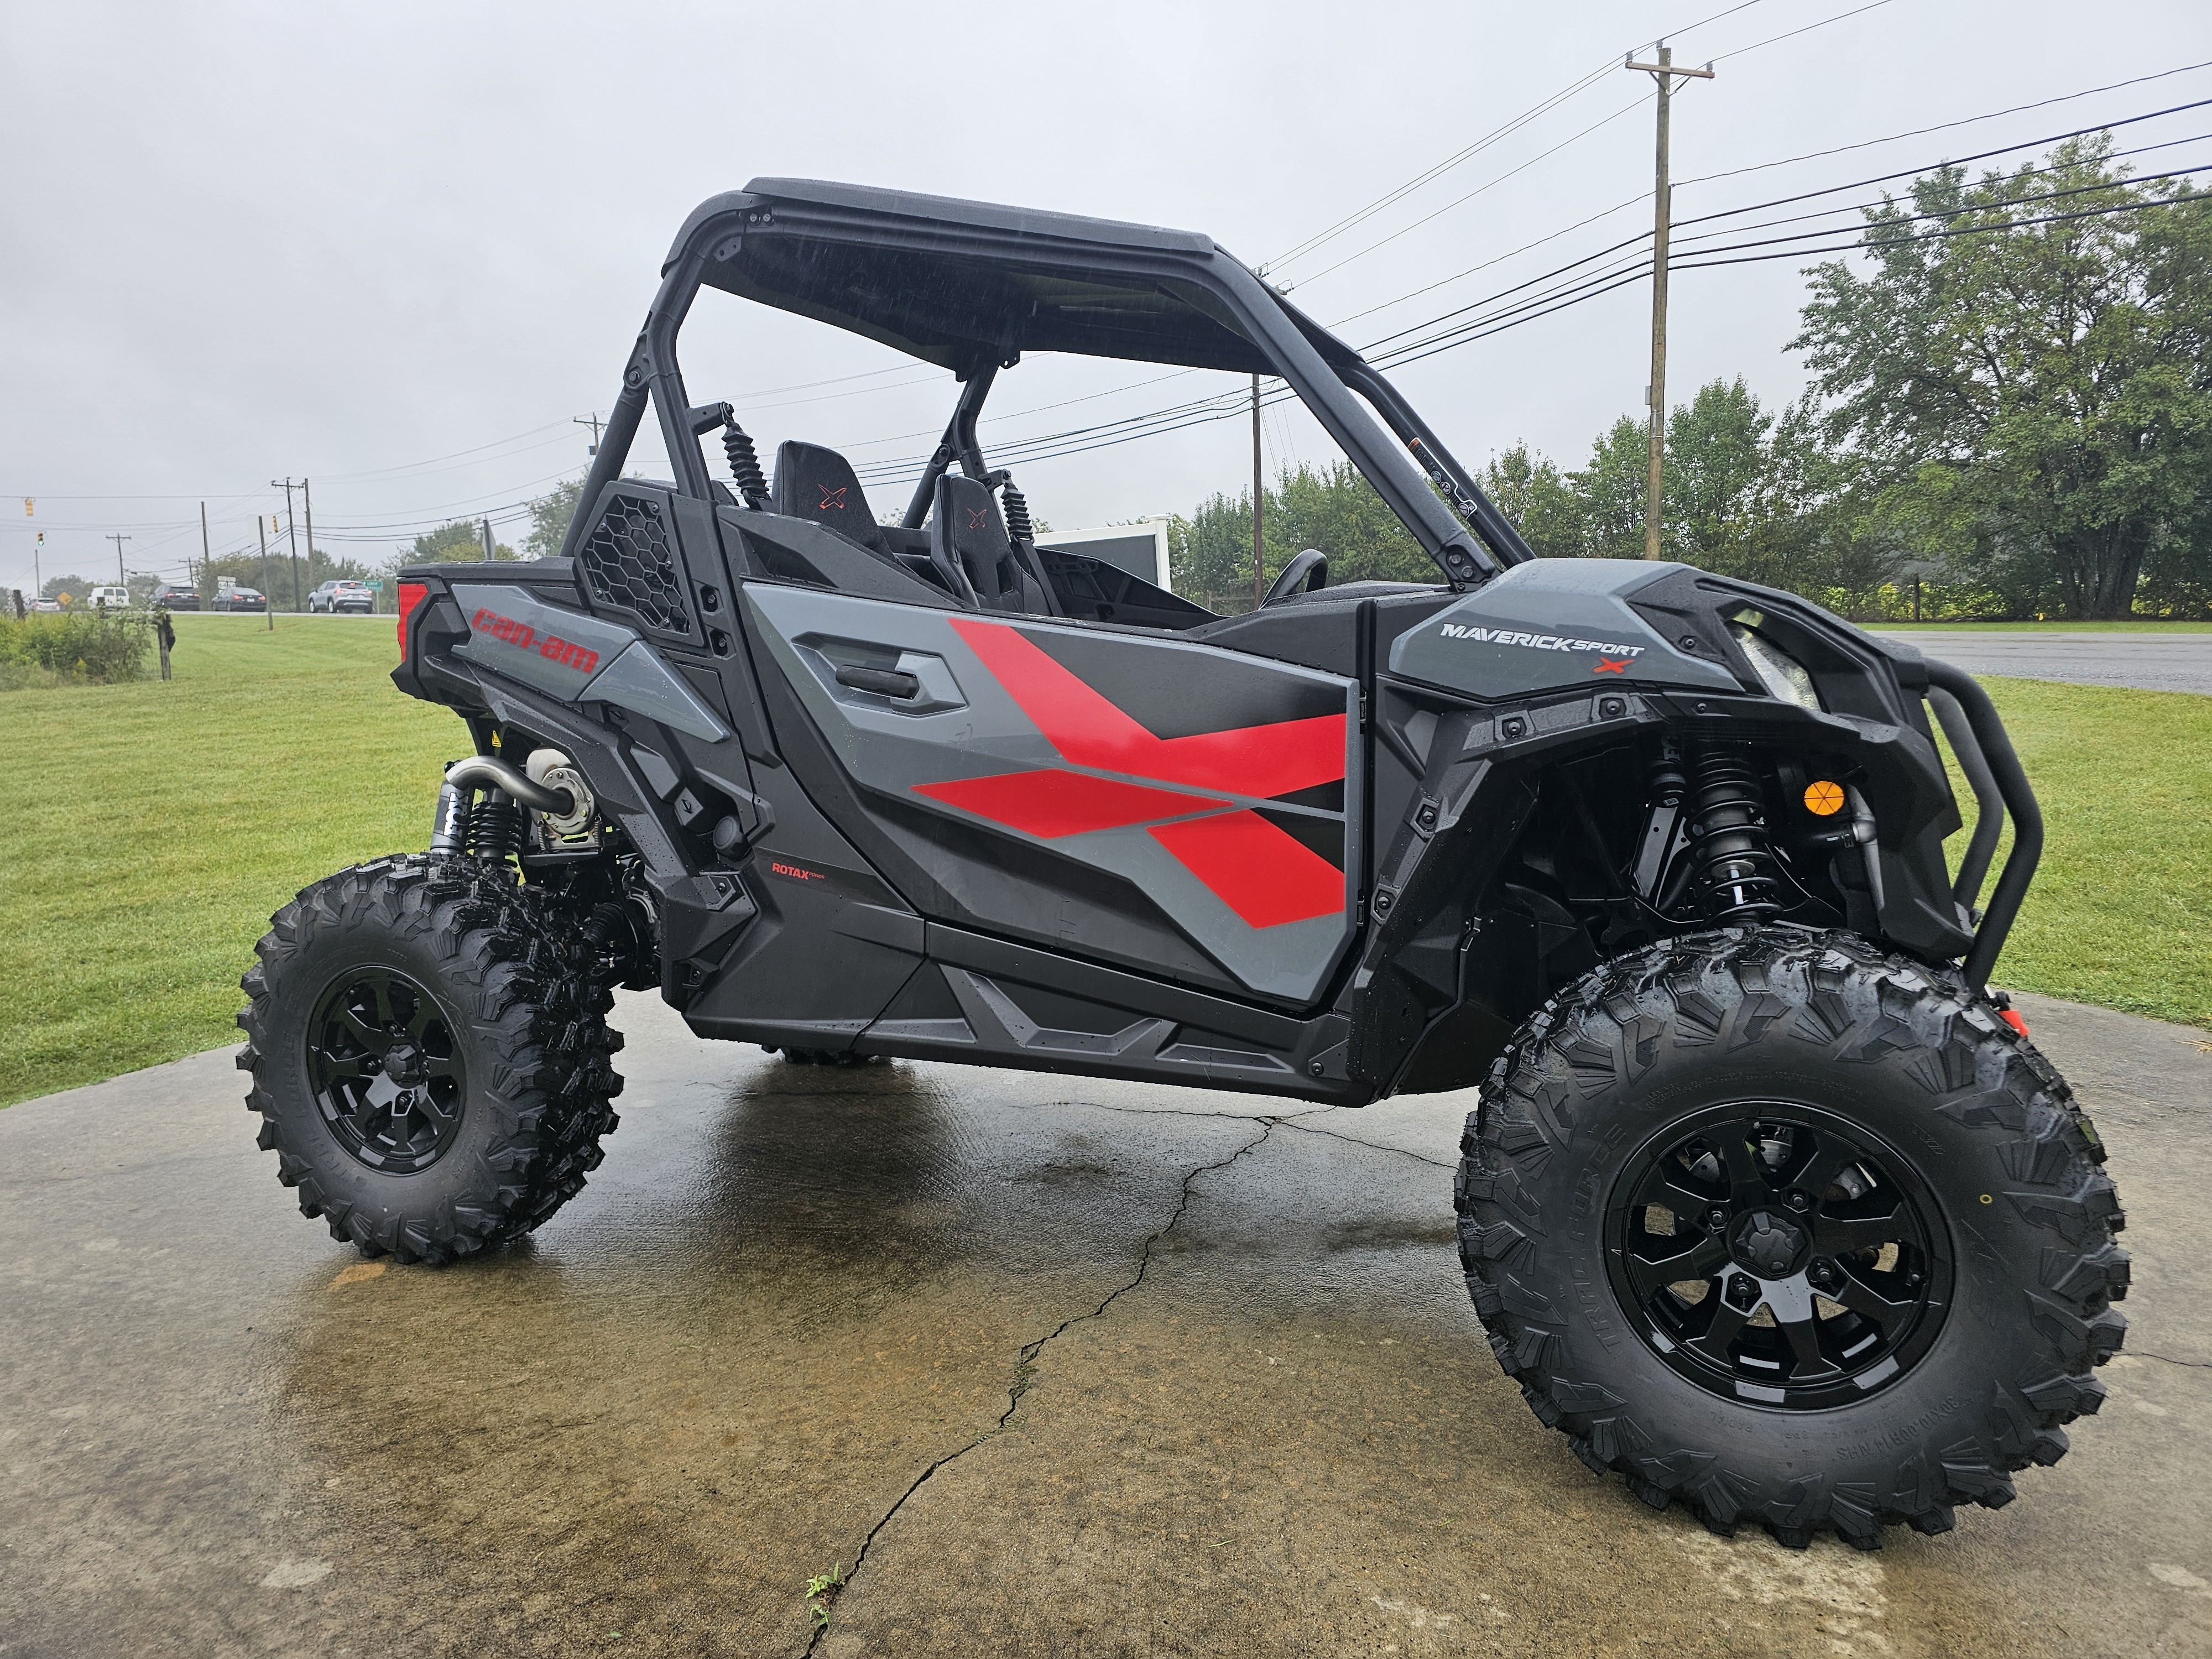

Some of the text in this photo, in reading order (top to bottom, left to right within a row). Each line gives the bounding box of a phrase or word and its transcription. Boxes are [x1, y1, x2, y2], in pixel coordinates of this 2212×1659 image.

[471, 607, 599, 674] can-am
[1440, 623, 1645, 656] MAVERICK SPORT
[444, 792, 469, 838] FOX
[772, 863, 809, 880] ROTAX
[1567, 1123, 1627, 1354] TRAC FORCE
